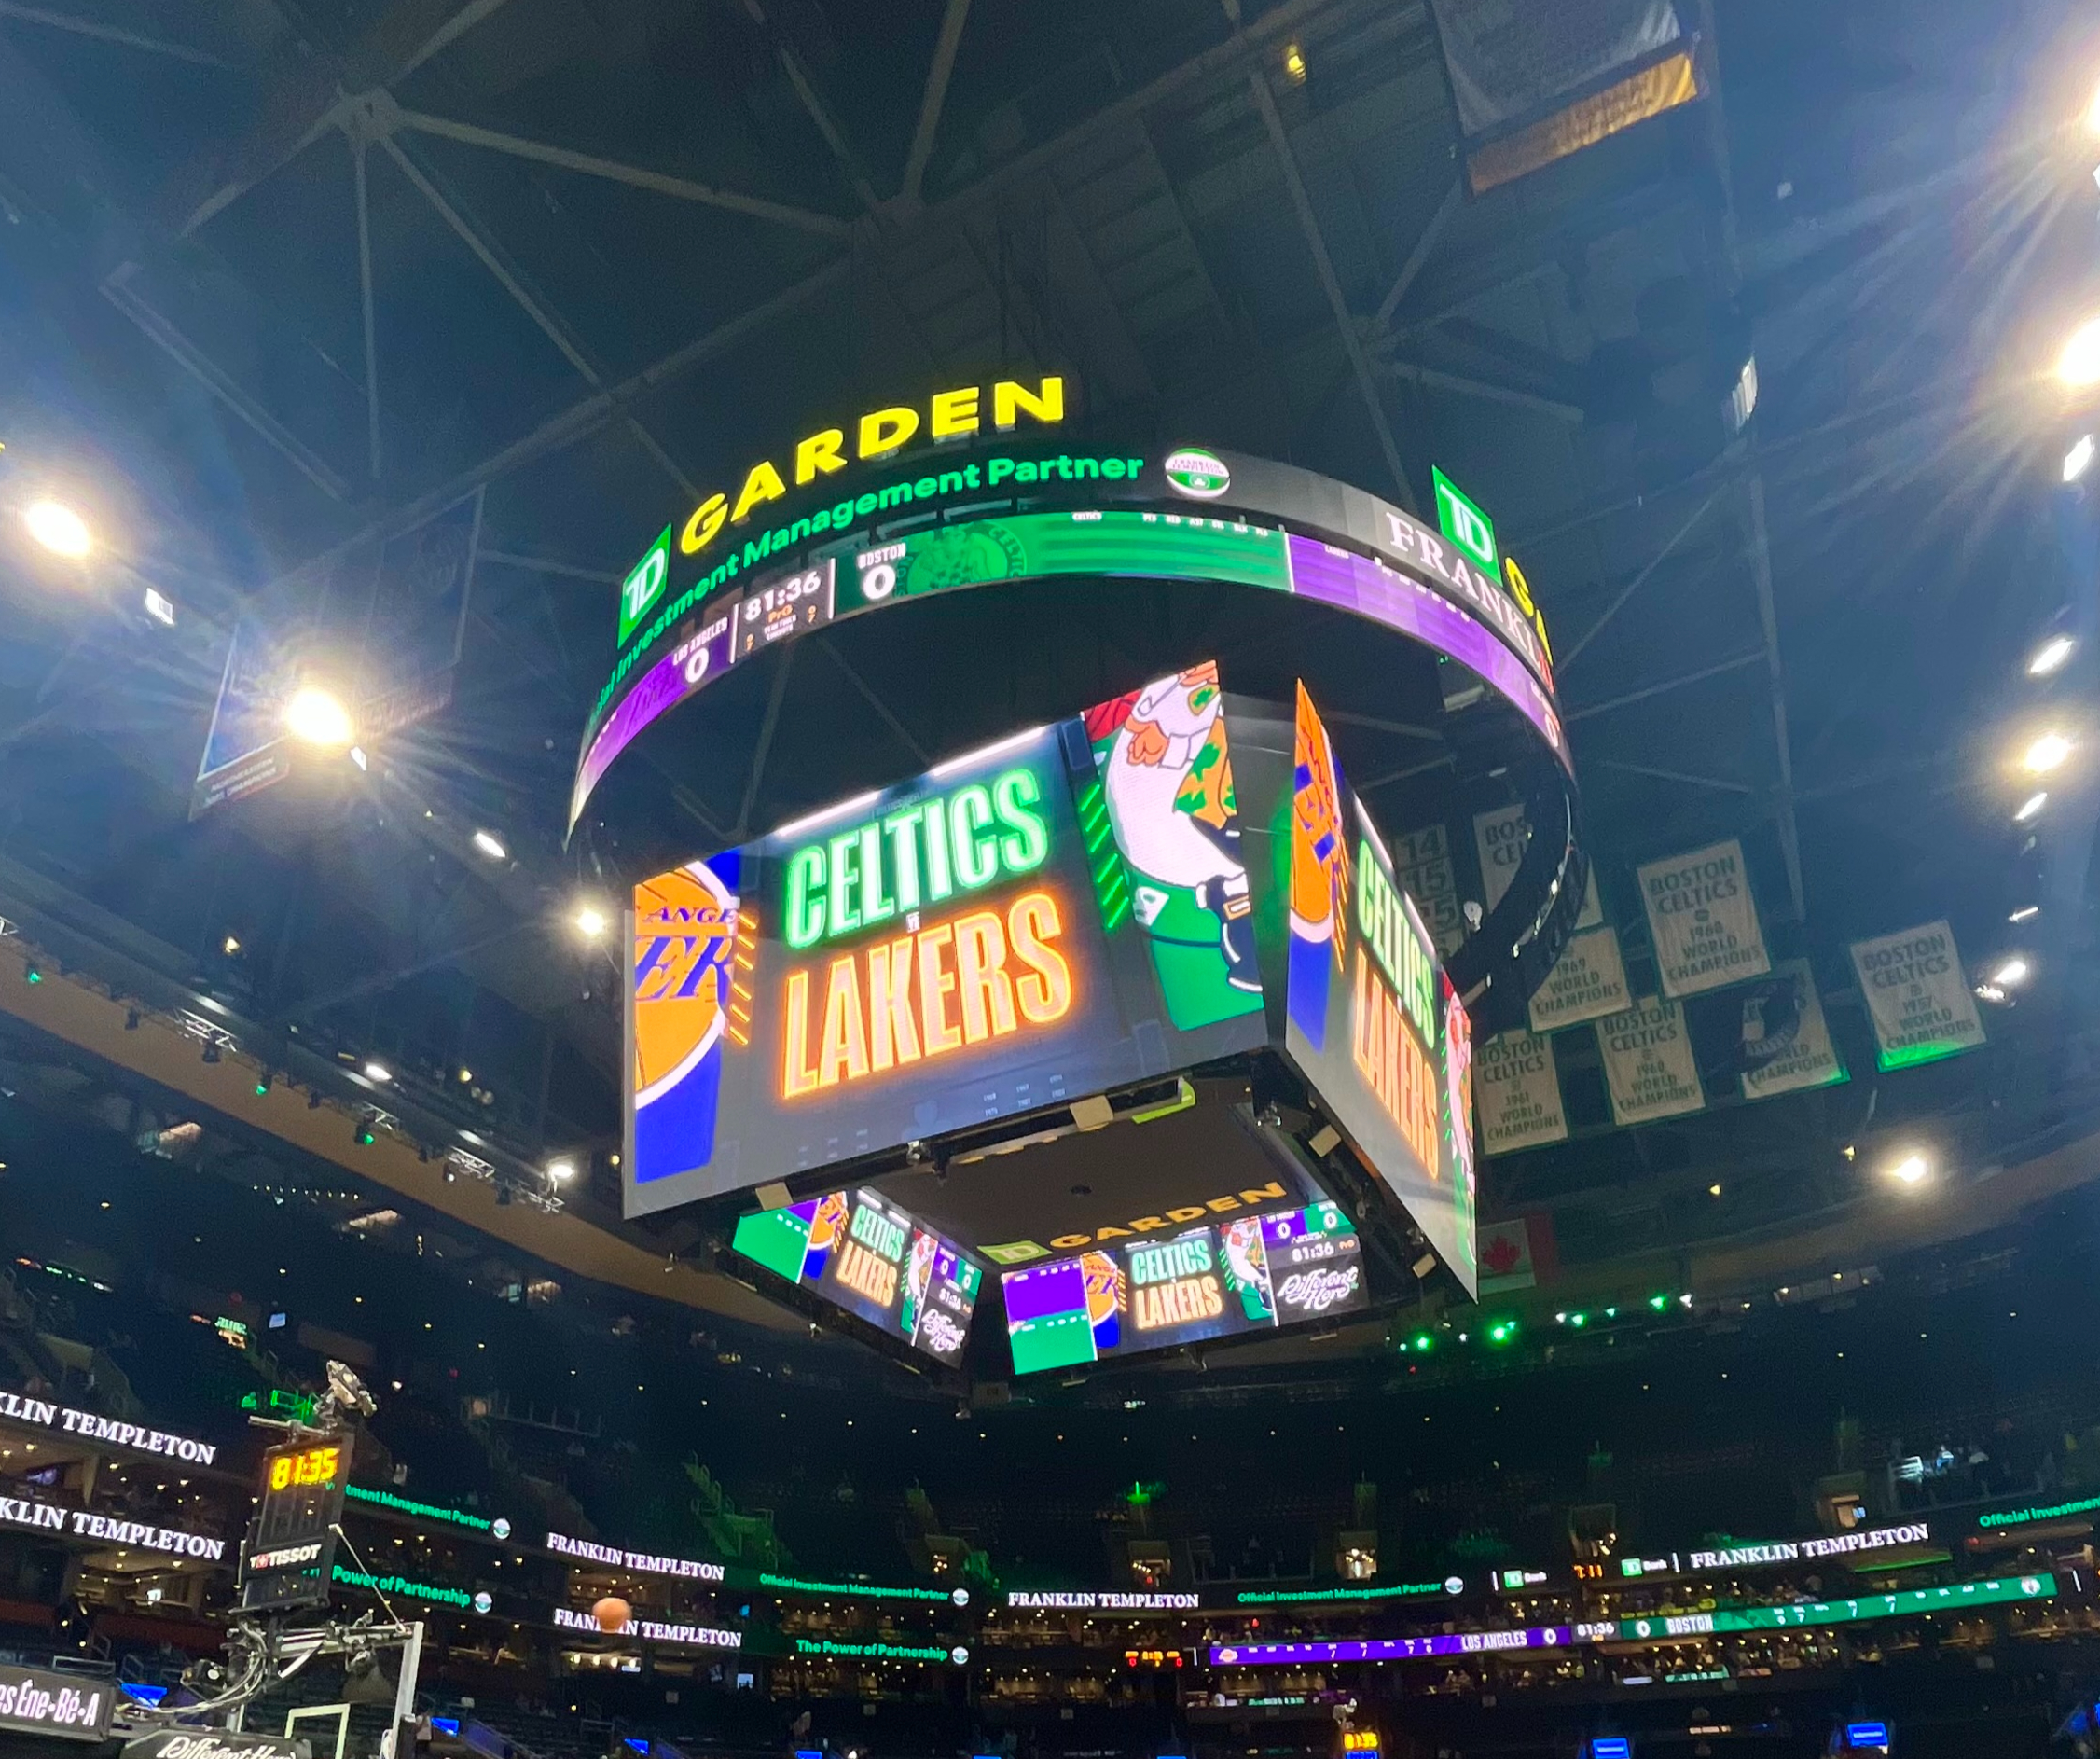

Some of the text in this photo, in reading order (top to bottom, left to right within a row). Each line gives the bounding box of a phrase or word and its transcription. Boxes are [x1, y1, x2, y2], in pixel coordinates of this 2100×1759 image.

[680, 377, 1064, 554] GARDEN
[1439, 482, 1492, 563] TD
[616, 454, 1144, 683] Investment Management Partner
[857, 542, 906, 570] BOSTON
[626, 547, 666, 621] TD
[745, 571, 822, 621] 81:36
[863, 564, 896, 600] 0
[685, 648, 710, 683] 0
[787, 768, 1049, 949] CELTICS
[1650, 855, 1737, 895] BOSTON
[1657, 878, 1738, 914] CELTICS
[1357, 838, 1435, 1050] CELTICS
[1682, 935, 1738, 959] WORLD
[1863, 934, 1947, 971] BOSTON
[1668, 945, 1761, 980] CHAMPIONS
[1872, 955, 1951, 989] CELTICS
[783, 893, 1072, 1100] LAKERS
[1534, 982, 1623, 1015] CHAMPIONS
[1549, 971, 1601, 994] WORLD
[1605, 1006, 1677, 1036] BOSTON
[1886, 1018, 1976, 1050] CHAMPIONS
[1898, 1008, 1953, 1031] WORLD
[1476, 1038, 1546, 1067] BOSTON
[1610, 1024, 1677, 1052] CELTICS
[1353, 942, 1440, 1181] LAKERS
[1483, 1056, 1545, 1084] CELTICS
[1618, 1086, 1696, 1112] CHAMPIONS
[1631, 1075, 1678, 1094] WORLD
[1487, 1115, 1560, 1141] CHAMPIONS
[1499, 1103, 1543, 1125] WORLD
[1049, 1181, 1287, 1248] GARDEN
[850, 1204, 905, 1263] CELTICS
[1131, 1239, 1212, 1286] CELTICS
[1292, 1242, 1335, 1263] 81:36
[836, 1240, 898, 1308] LAKERS
[1277, 1265, 1360, 1304] Different
[1135, 1275, 1224, 1330] LAKERS
[1303, 1285, 1352, 1310] Here
[62, 1407, 217, 1466] TEMPLETON
[271, 1447, 341, 1490] 81:35
[380, 1492, 451, 1520] Management
[452, 1510, 490, 1530] Partner
[1980, 1509, 2030, 1528] Official
[72, 1512, 226, 1560] TEMPLETON
[1690, 1523, 1929, 1569] FRANKLIN TEMPLETON
[269, 1544, 322, 1567] TISSOT
[546, 1532, 725, 1582] FRANKLIN TEMPLETON
[332, 1565, 471, 1608] Power of Partnership
[794, 1578, 848, 1594] Investment
[849, 1584, 913, 1599] Management
[914, 1587, 950, 1600] Partner
[1008, 1592, 1199, 1609] FRANKLIN TEMPLETON
[1237, 1582, 1442, 1603] Official Investment Management Partner
[554, 1608, 742, 1648] FRANIN TEMPLETON
[1460, 1629, 1527, 1651] LOS ANGELES
[1543, 1628, 1557, 1645] 0
[1577, 1622, 1615, 1637] 81:36
[1636, 1620, 1651, 1637] 0
[1666, 1614, 1713, 1633] BOSTON
[796, 1639, 948, 1662] The Power of Partnership
